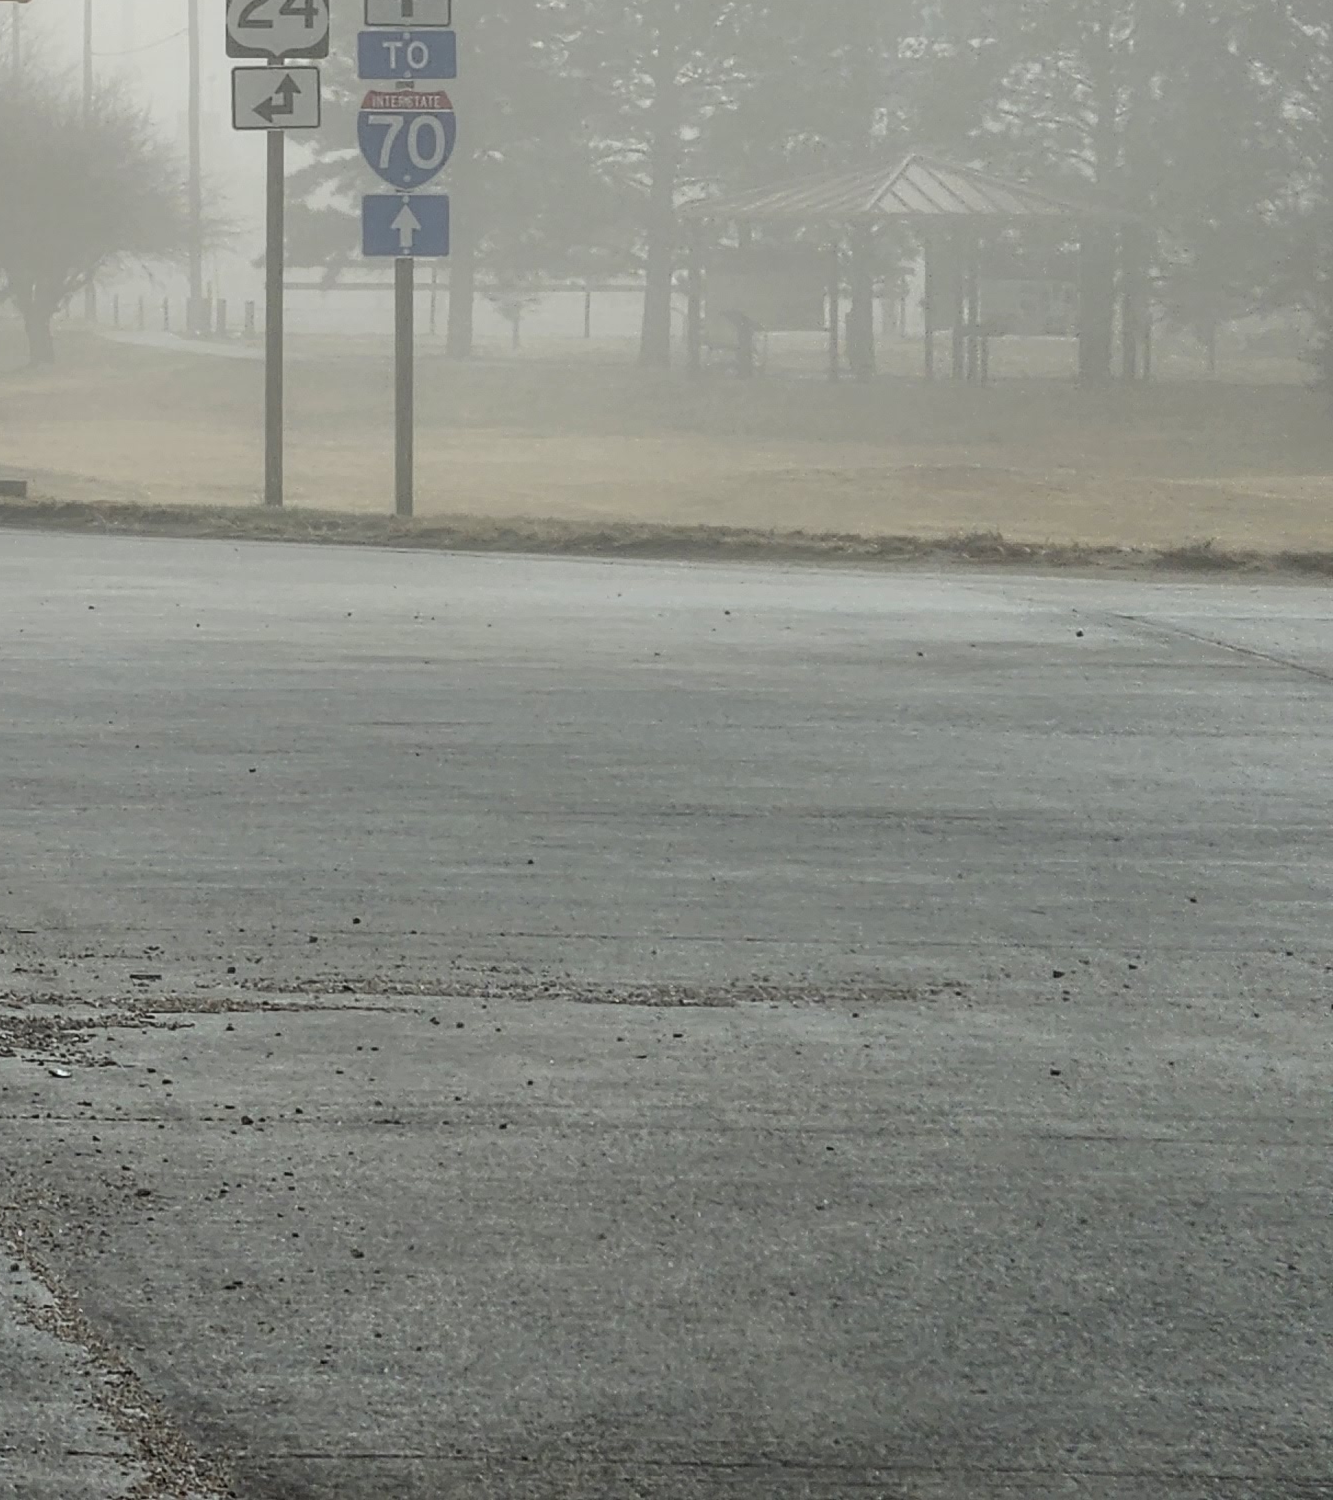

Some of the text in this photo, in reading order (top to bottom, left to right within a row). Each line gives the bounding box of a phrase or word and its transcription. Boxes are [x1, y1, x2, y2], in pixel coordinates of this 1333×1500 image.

[383, 41, 429, 69] TO
[372, 95, 441, 108] INTERSTATE
[368, 115, 446, 170] 70
